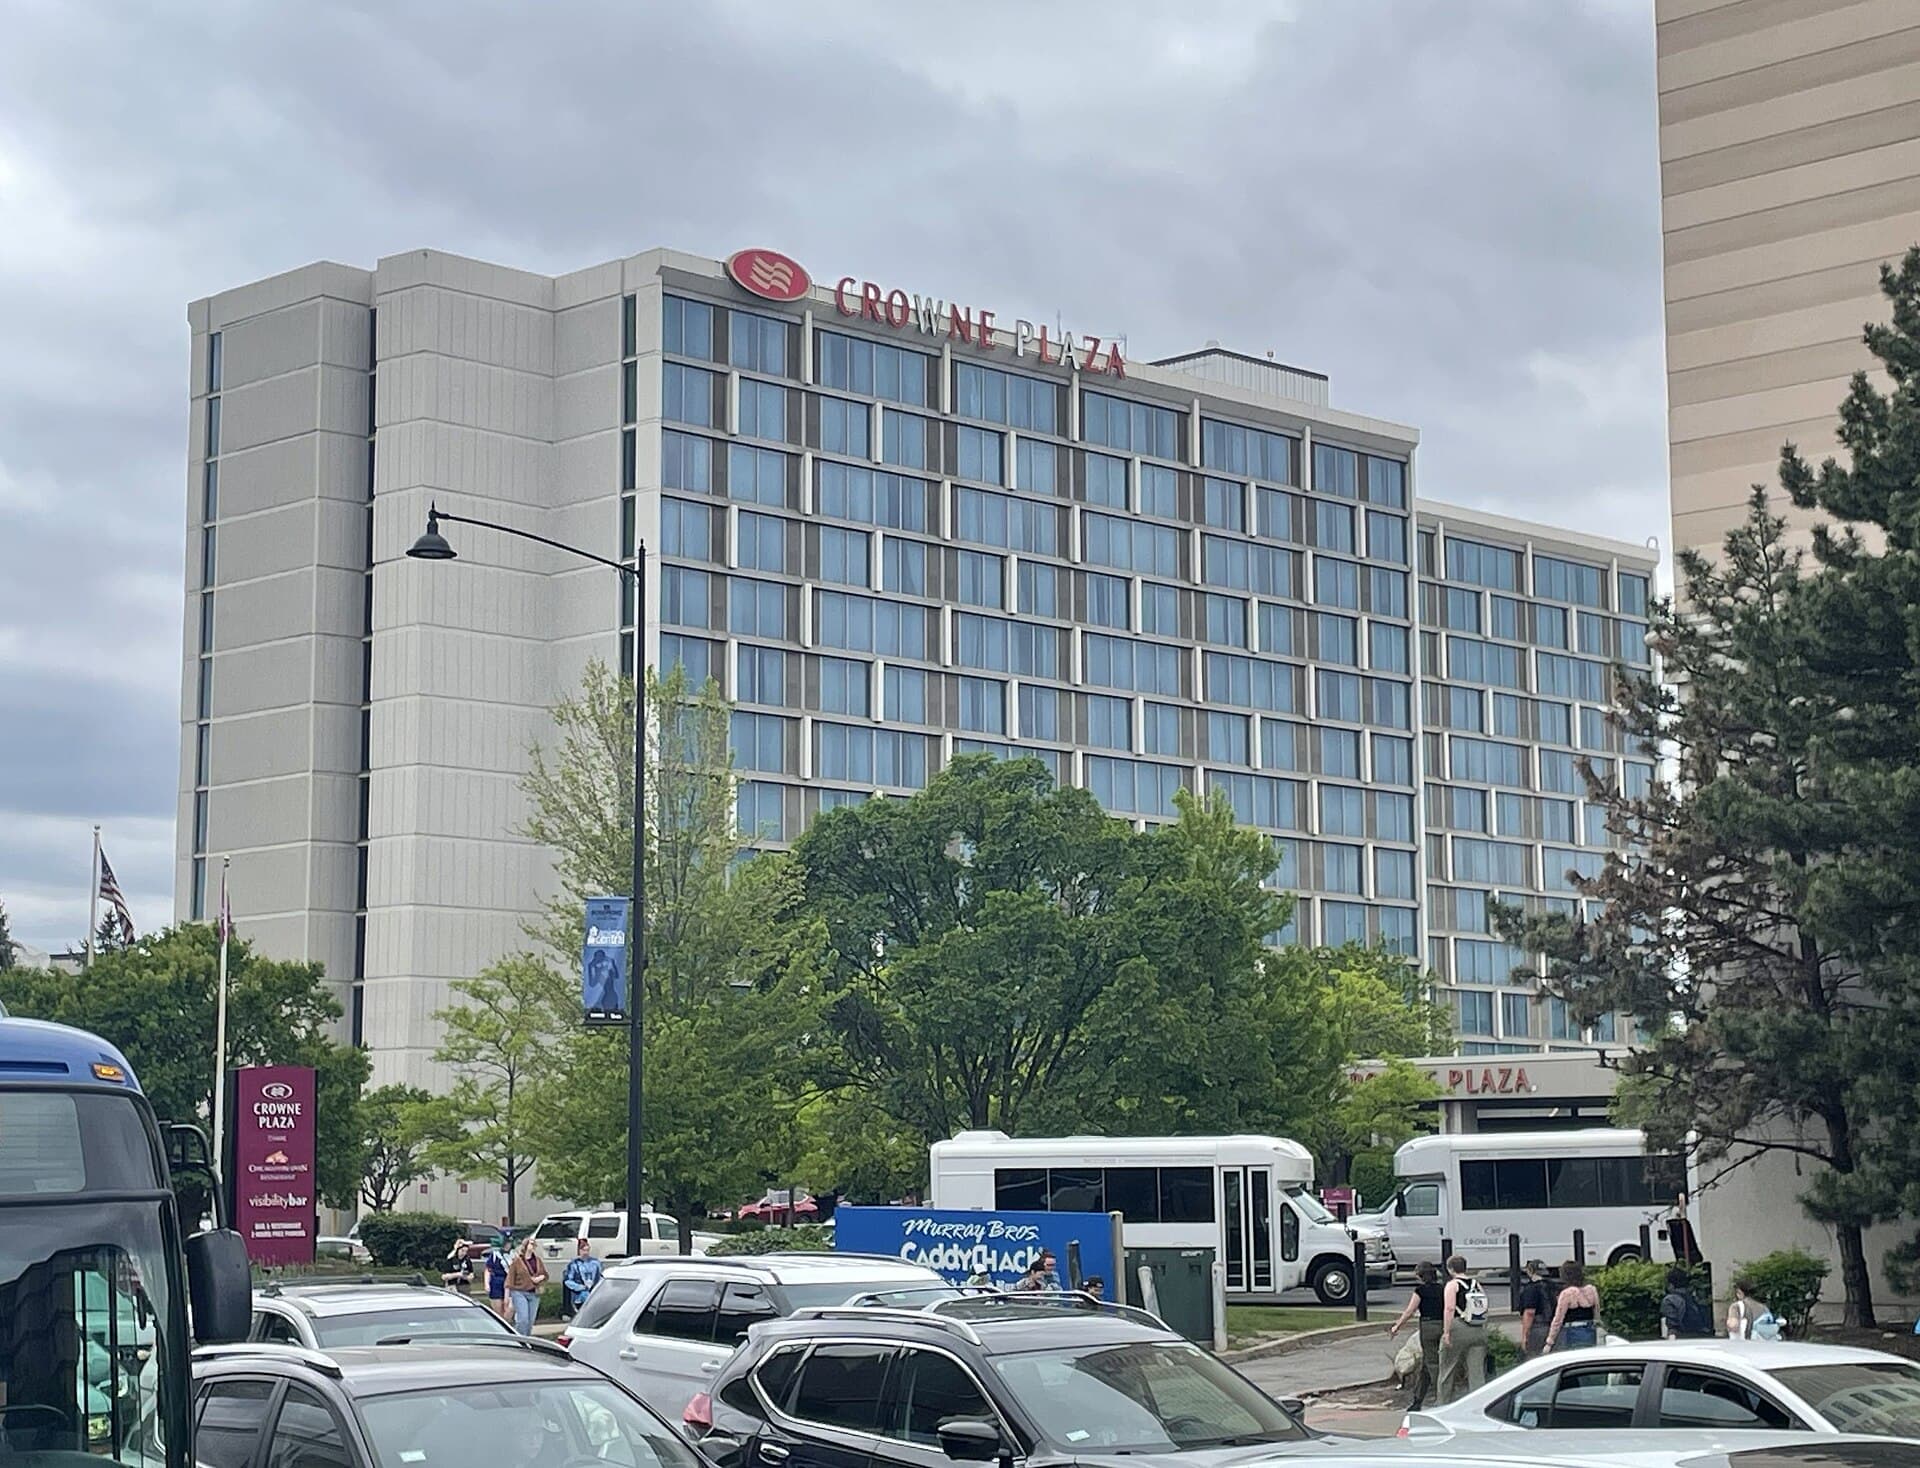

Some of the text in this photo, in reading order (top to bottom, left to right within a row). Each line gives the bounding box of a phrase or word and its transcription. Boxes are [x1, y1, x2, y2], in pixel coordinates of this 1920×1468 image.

[835, 277, 1126, 380] CROWNE PLAZA
[1449, 1068, 1532, 1094] PLAZA
[253, 1102, 302, 1116] CROWNE
[259, 1116, 295, 1129] PLAZA
